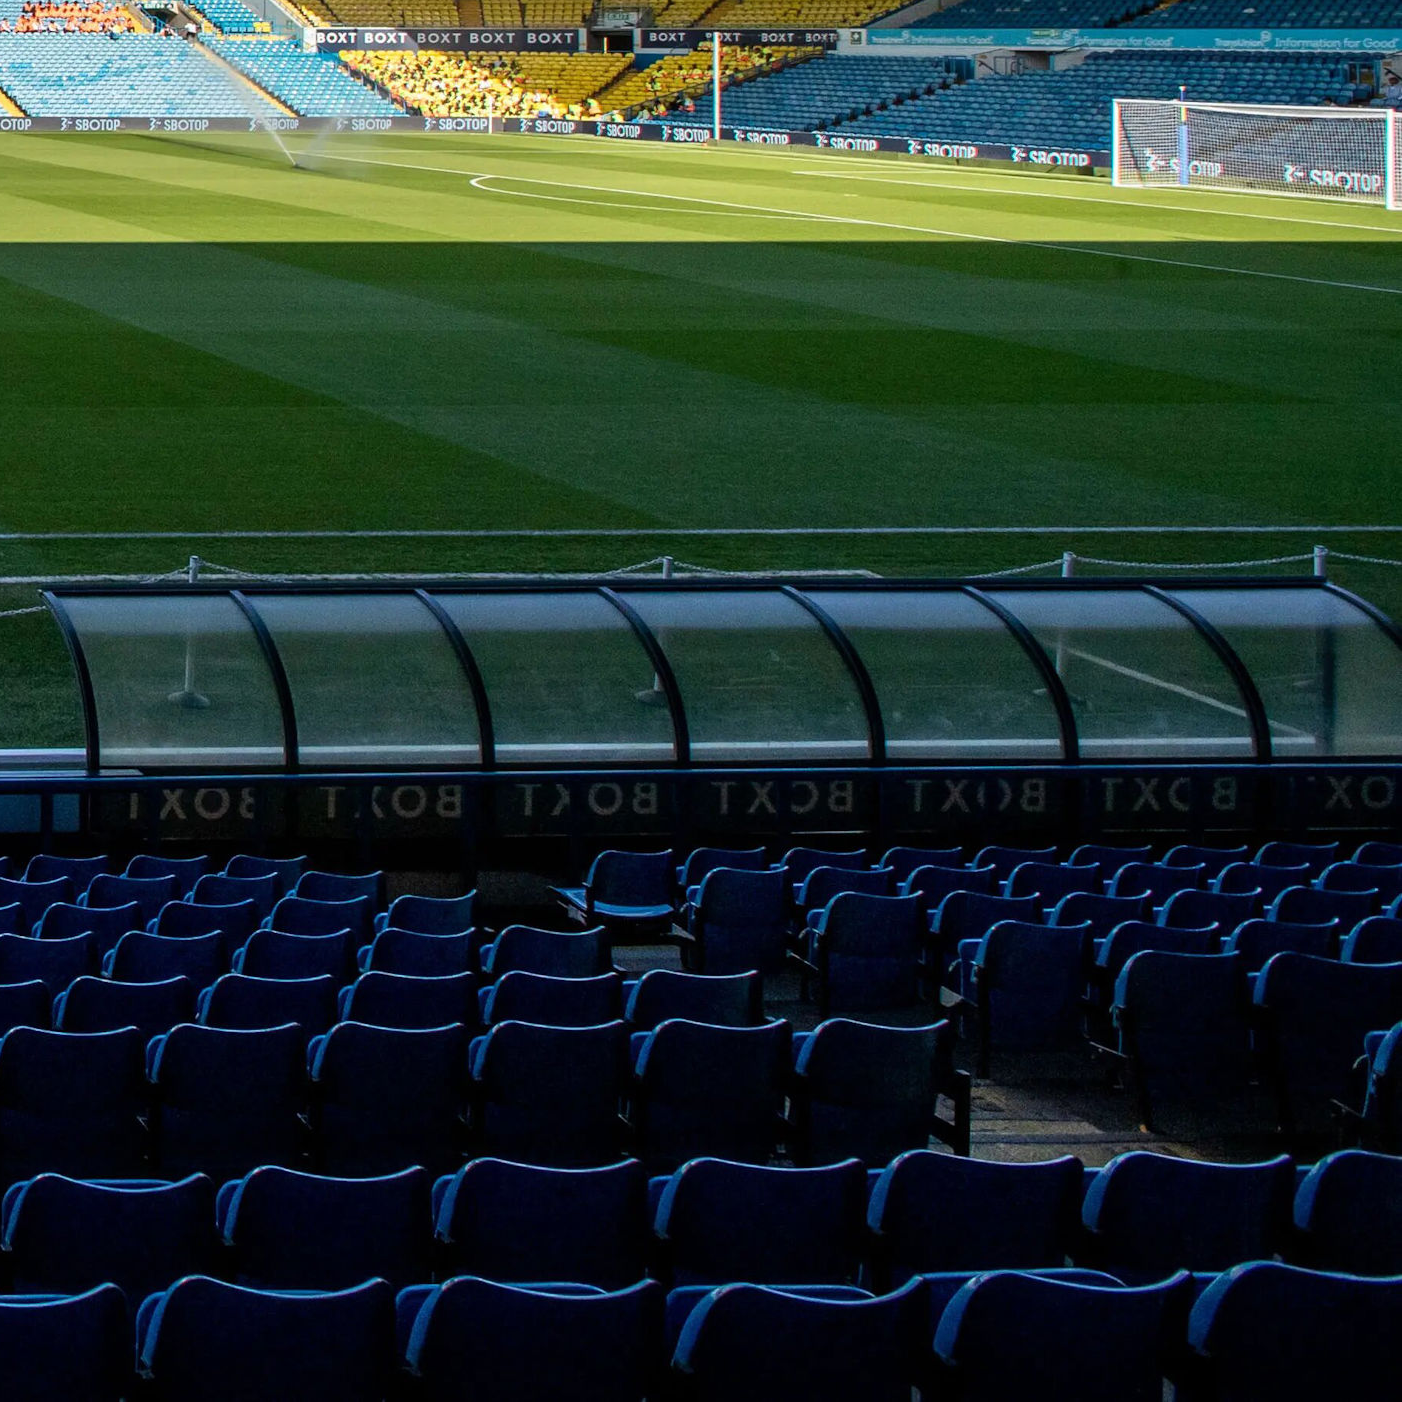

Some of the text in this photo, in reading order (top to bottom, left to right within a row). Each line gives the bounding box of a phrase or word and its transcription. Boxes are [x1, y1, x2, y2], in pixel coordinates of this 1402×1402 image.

[316, 32, 357, 44] BOXT
[364, 32, 408, 44] BOXT
[417, 32, 461, 44] BOXT
[469, 32, 516, 44] BOXT
[526, 32, 574, 44] BOXT
[649, 32, 686, 42] BOXT
[761, 32, 796, 43] BOXT
[1274, 37, 1342, 48] Information
[1343, 37, 1359, 48] for
[1363, 37, 1398, 48] Good
[74, 119, 121, 131] SBOTOP
[164, 119, 209, 131] SBOTOP
[345, 119, 392, 131] SBOTOP
[439, 119, 488, 131] SBOTOP
[535, 120, 575, 134] SBOTOP
[607, 123, 640, 139] SBOTOP
[673, 127, 710, 143] SBOTOP
[1169, 157, 1224, 177] SOTOP
